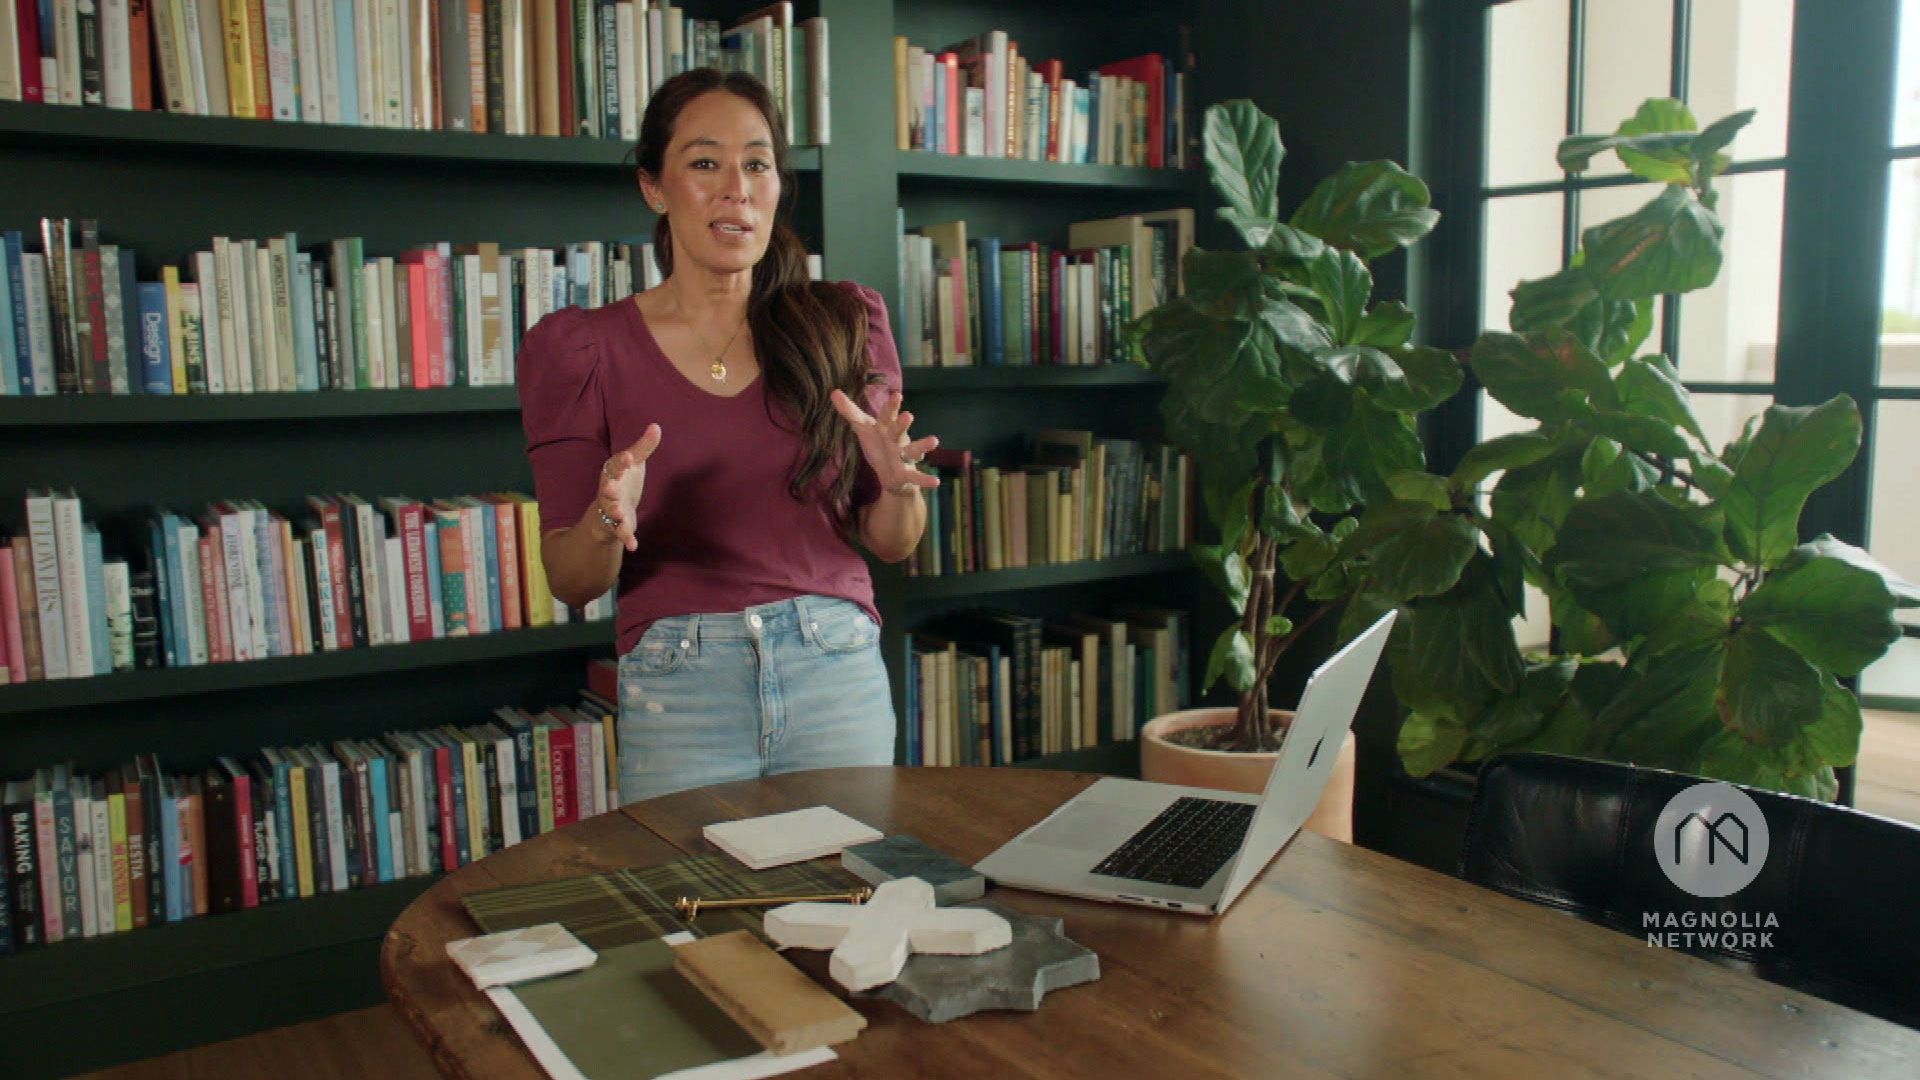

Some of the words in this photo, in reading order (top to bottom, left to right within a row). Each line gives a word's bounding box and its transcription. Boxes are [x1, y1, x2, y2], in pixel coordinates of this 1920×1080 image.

[143, 312, 161, 364] Design
[553, 750, 566, 817] COOKBOOK
[12, 812, 32, 874] BAKING
[58, 816, 78, 912] SAVOR
[128, 834, 143, 880] BESTIA
